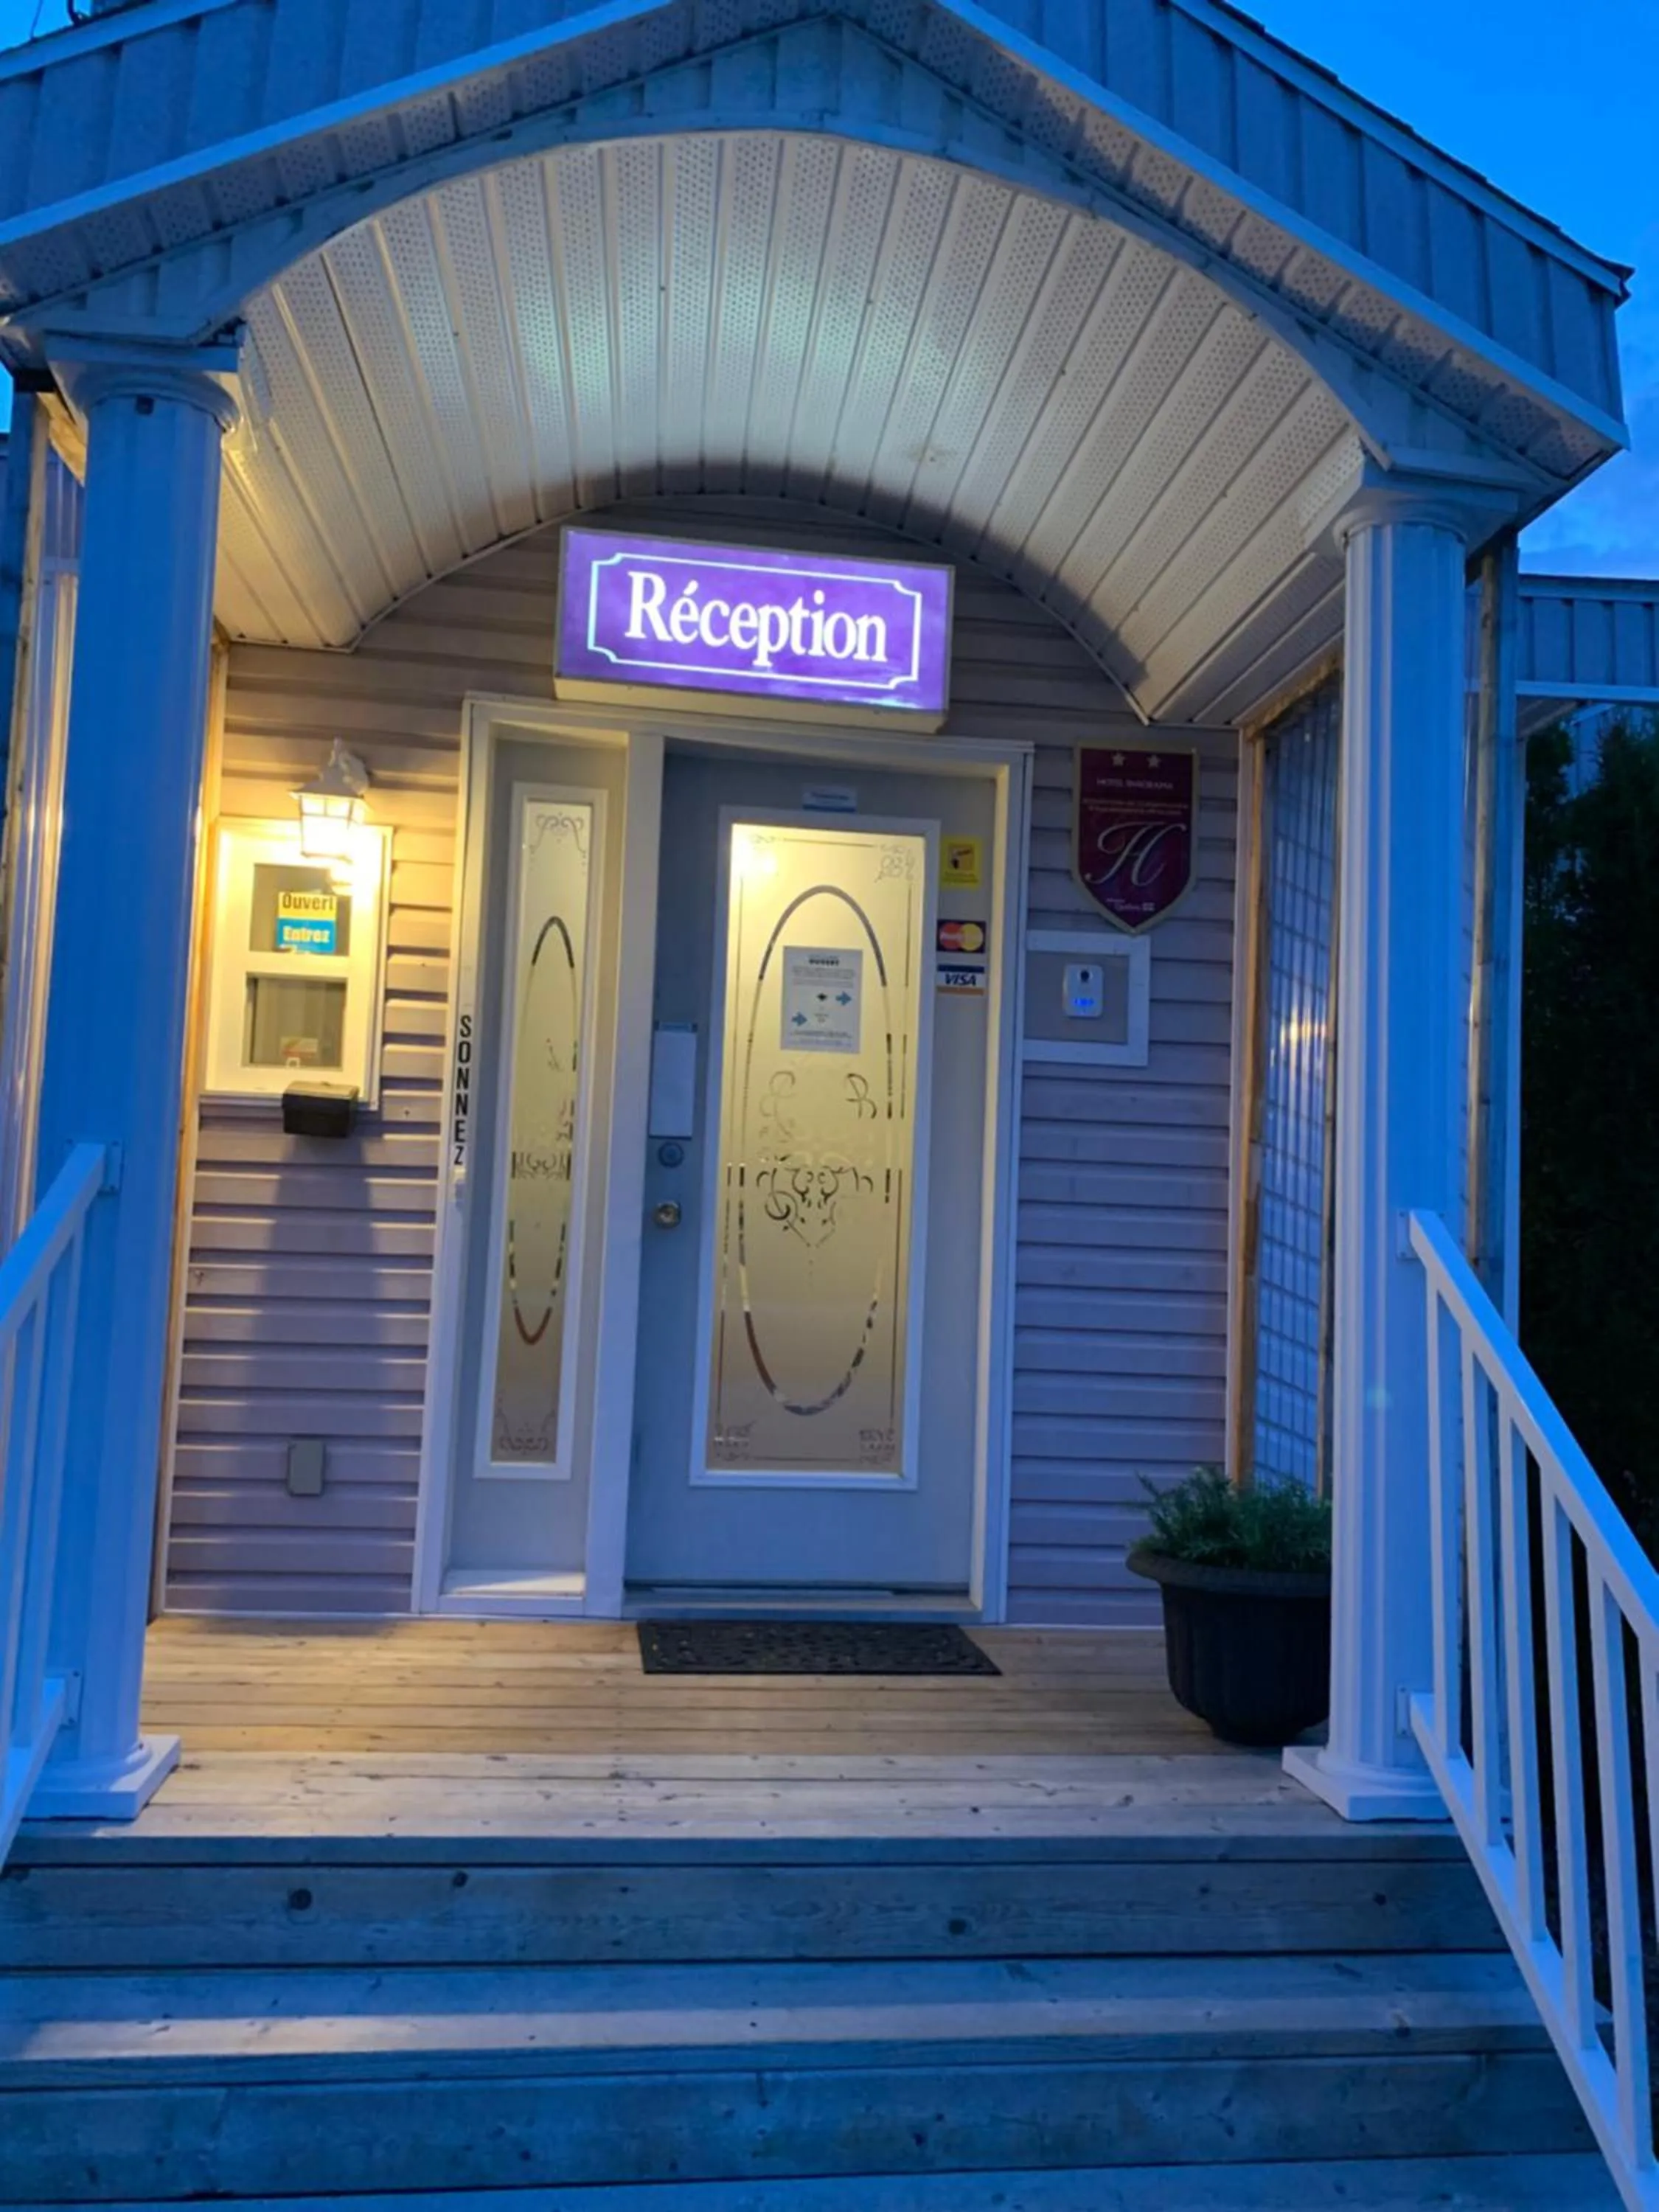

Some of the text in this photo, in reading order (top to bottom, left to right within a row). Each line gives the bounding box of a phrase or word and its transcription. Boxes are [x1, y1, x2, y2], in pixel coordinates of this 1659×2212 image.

[625, 571, 887, 667] Réception
[945, 973, 977, 986] VISA
[453, 1015, 472, 1165] SONNEZ
